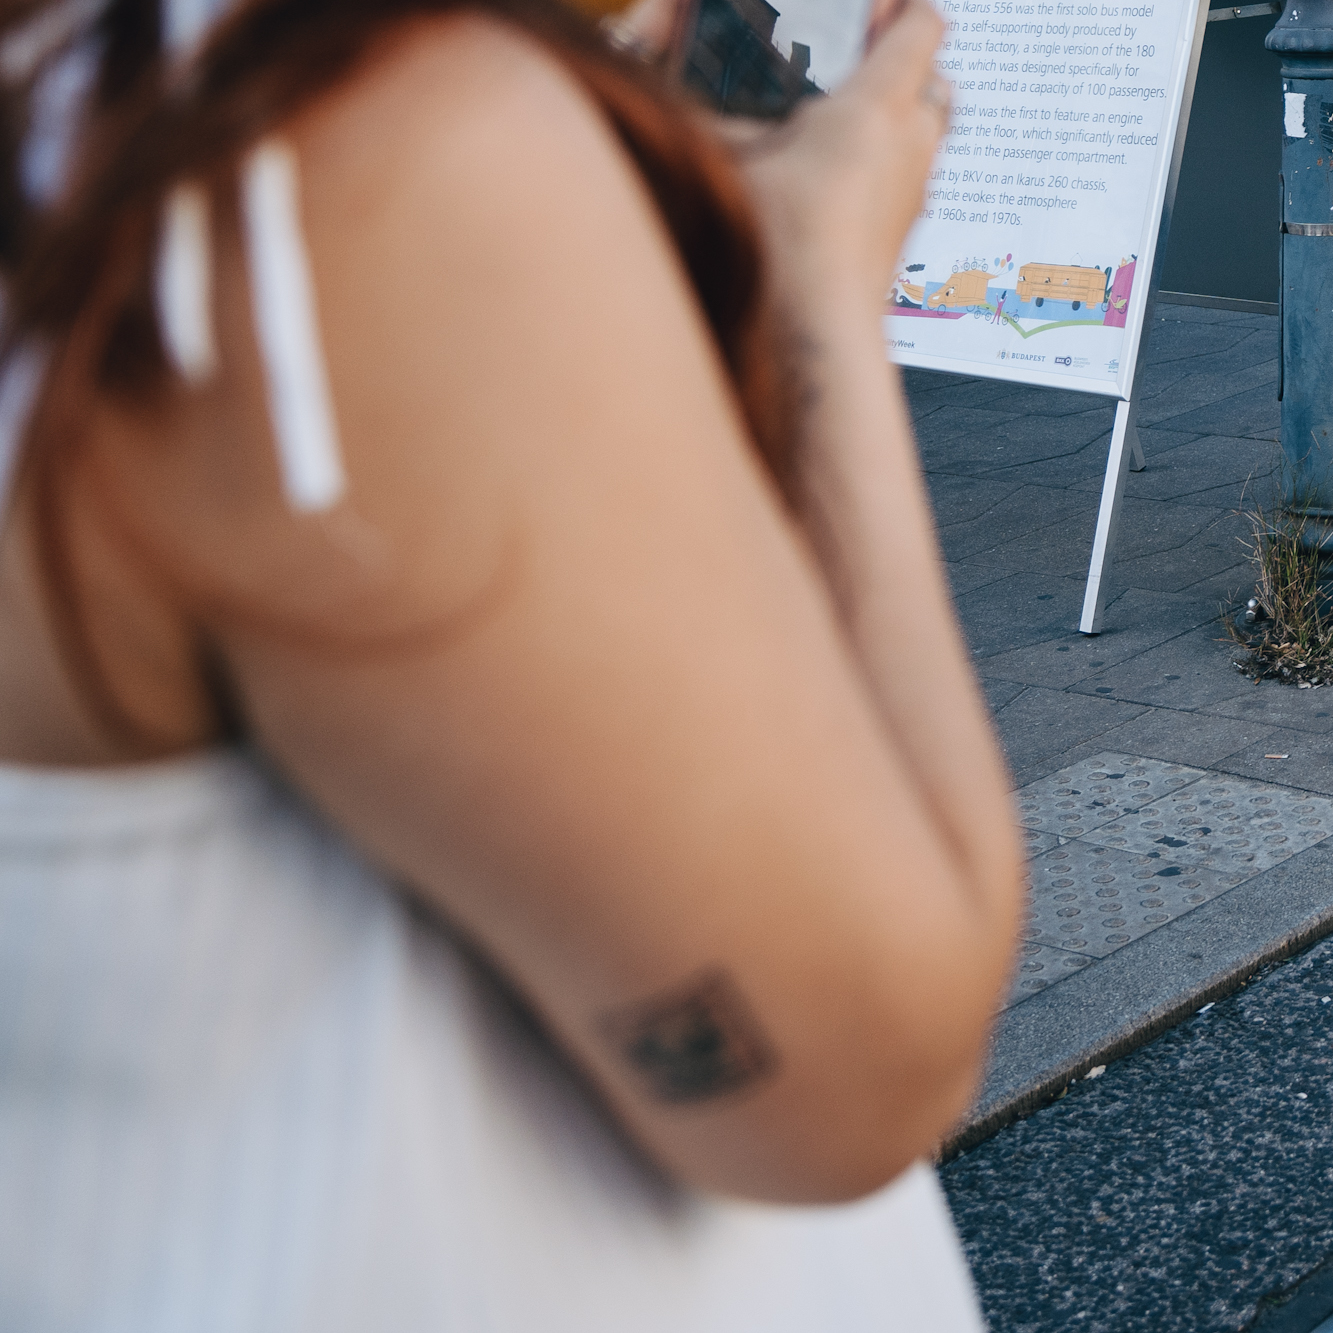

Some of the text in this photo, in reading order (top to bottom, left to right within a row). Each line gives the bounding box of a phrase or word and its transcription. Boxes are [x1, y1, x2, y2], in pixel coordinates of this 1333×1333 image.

[943, 0, 1155, 17] The Ikarus 556 was the first solo bus model
[962, 22, 969, 32] a
[970, 19, 1043, 38] self-supporting
[1045, 21, 1071, 38] body
[1072, 23, 1122, 38] produced
[1124, 23, 1137, 40] by
[954, 38, 982, 52] Ikarus
[985, 39, 1020, 57] factory,
[1023, 44, 1029, 53] a
[1031, 42, 1061, 58] single
[1063, 42, 1099, 56] version
[1101, 43, 1114, 56] of
[1115, 44, 1132, 57] the
[1136, 44, 1155, 57] 180
[968, 58, 997, 72] which
[999, 62, 1019, 73] was
[1021, 60, 1067, 77] designed
[1068, 62, 1122, 80] specifically
[1124, 63, 1140, 77] for
[958, 80, 976, 91] use
[977, 78, 998, 91] and
[999, 79, 1019, 92] had
[1020, 83, 1027, 92] a
[1029, 81, 1071, 97] capacity
[1072, 82, 1085, 96] of
[1087, 83, 1107, 96] 100
[1108, 85, 1167, 101] passengers.
[978, 107, 998, 118] was
[1000, 106, 1017, 119] the
[1019, 106, 1038, 120] first
[1040, 107, 1051, 120] to
[1054, 108, 1090, 123] feature
[1092, 112, 1105, 123] an
[1108, 111, 1144, 127] engine
[975, 124, 992, 137] the
[993, 124, 1018, 140] floor,
[1022, 127, 1052, 140] which
[1054, 128, 1115, 147] significantly
[1116, 132, 1159, 146] reduced
[945, 141, 971, 156] levels
[973, 143, 982, 156] in
[985, 144, 1001, 157] the
[1002, 147, 1054, 163] passenger
[1055, 151, 1128, 165] compartment.
[948, 170, 960, 183] by
[962, 170, 983, 183] BKV
[985, 175, 998, 184] on
[1001, 175, 1014, 185] an
[1016, 173, 1045, 187] Ikarus
[1047, 175, 1068, 189] 260
[1071, 177, 1108, 192] chassis,
[927, 187, 1078, 210] vehicle evokes the atmosphere
[937, 207, 967, 222] 1960s
[969, 210, 988, 223] and
[992, 212, 1023, 226] 1970s.
[1011, 352, 1046, 362] BUDAPEST
